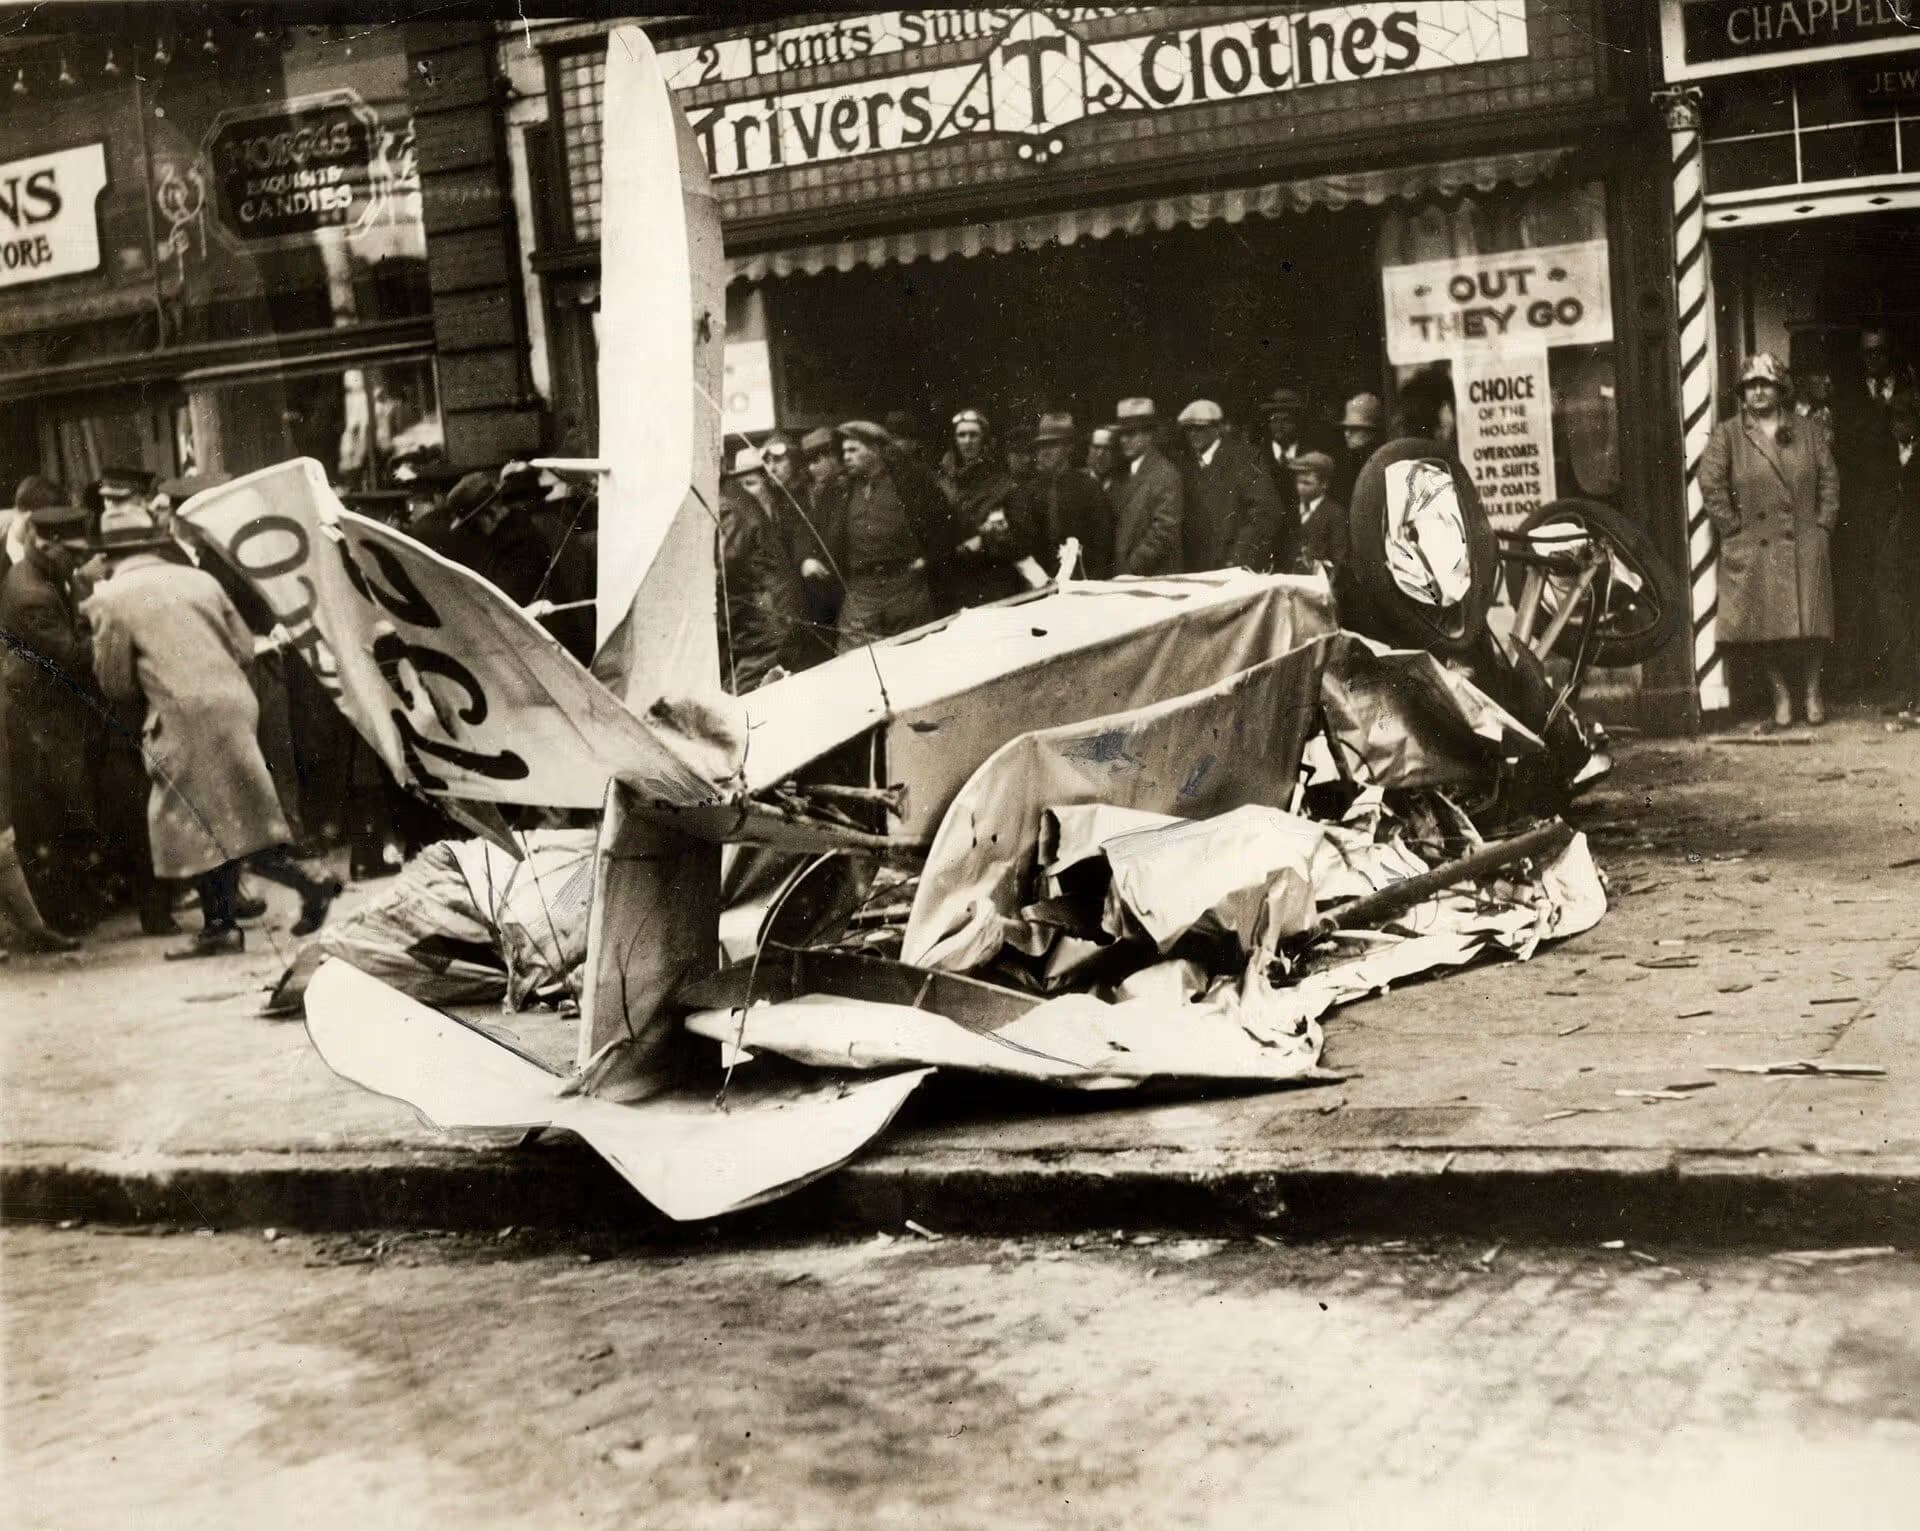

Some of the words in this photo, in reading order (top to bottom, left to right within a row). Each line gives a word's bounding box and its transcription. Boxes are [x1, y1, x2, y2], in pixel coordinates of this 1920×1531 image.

[697, 46, 720, 84] 2
[748, 24, 873, 76] Pants
[1140, 10, 1420, 105] Clothes
[240, 183, 353, 222] CANDIES
[0, 236, 53, 269] ORE
[1449, 265, 1535, 303] OUT
[1409, 304, 1517, 341] THEY
[1526, 297, 1584, 328] GO
[1469, 374, 1535, 403] CHOICE
[1478, 407, 1496, 420] OF
[1500, 404, 1526, 418] THE
[1479, 421, 1529, 438] HOUSE
[1473, 443, 1539, 461] OVERCOATS
[1501, 462, 1540, 478] SUITS
[1501, 481, 1541, 497] COATS
